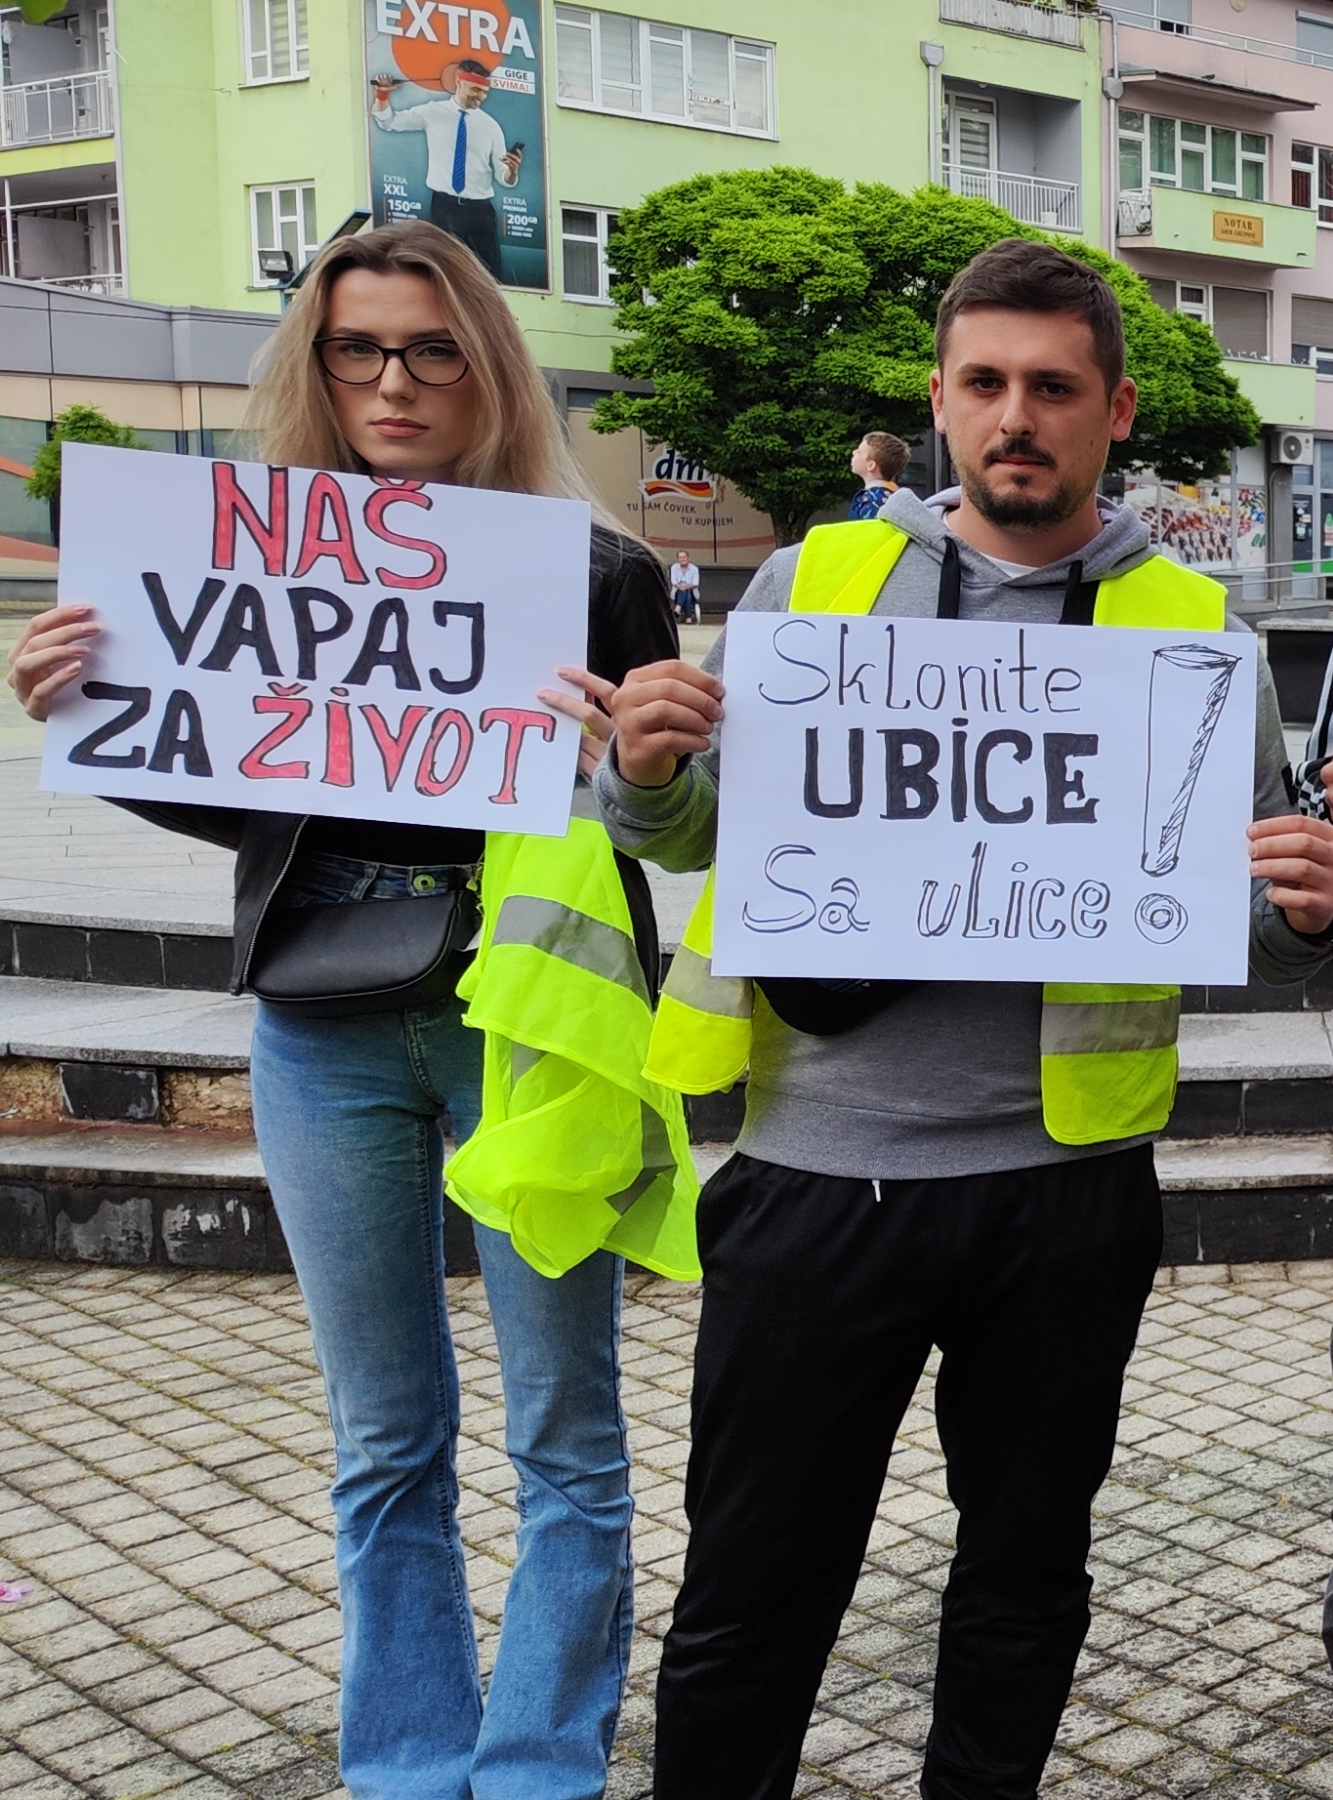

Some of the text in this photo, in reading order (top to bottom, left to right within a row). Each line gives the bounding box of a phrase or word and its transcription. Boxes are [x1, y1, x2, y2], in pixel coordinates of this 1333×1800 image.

[376, 0, 536, 60] EXTRA
[504, 69, 530, 81] GIGE
[492, 79, 530, 93] SVIMA!
[383, 174, 408, 185] EXTRA
[383, 184, 408, 197] XXL
[502, 196, 527, 207] EXTRA
[1223, 217, 1253, 231] NOTAR
[655, 448, 706, 480] dm
[626, 501, 697, 515] TU SAM ČOVJEK
[212, 461, 448, 590] NAŠ
[680, 516, 693, 526] TU
[140, 571, 486, 695] VAPAJ
[757, 618, 1083, 714] Sklonite
[67, 680, 214, 778] ZA
[742, 842, 871, 935] Sa
